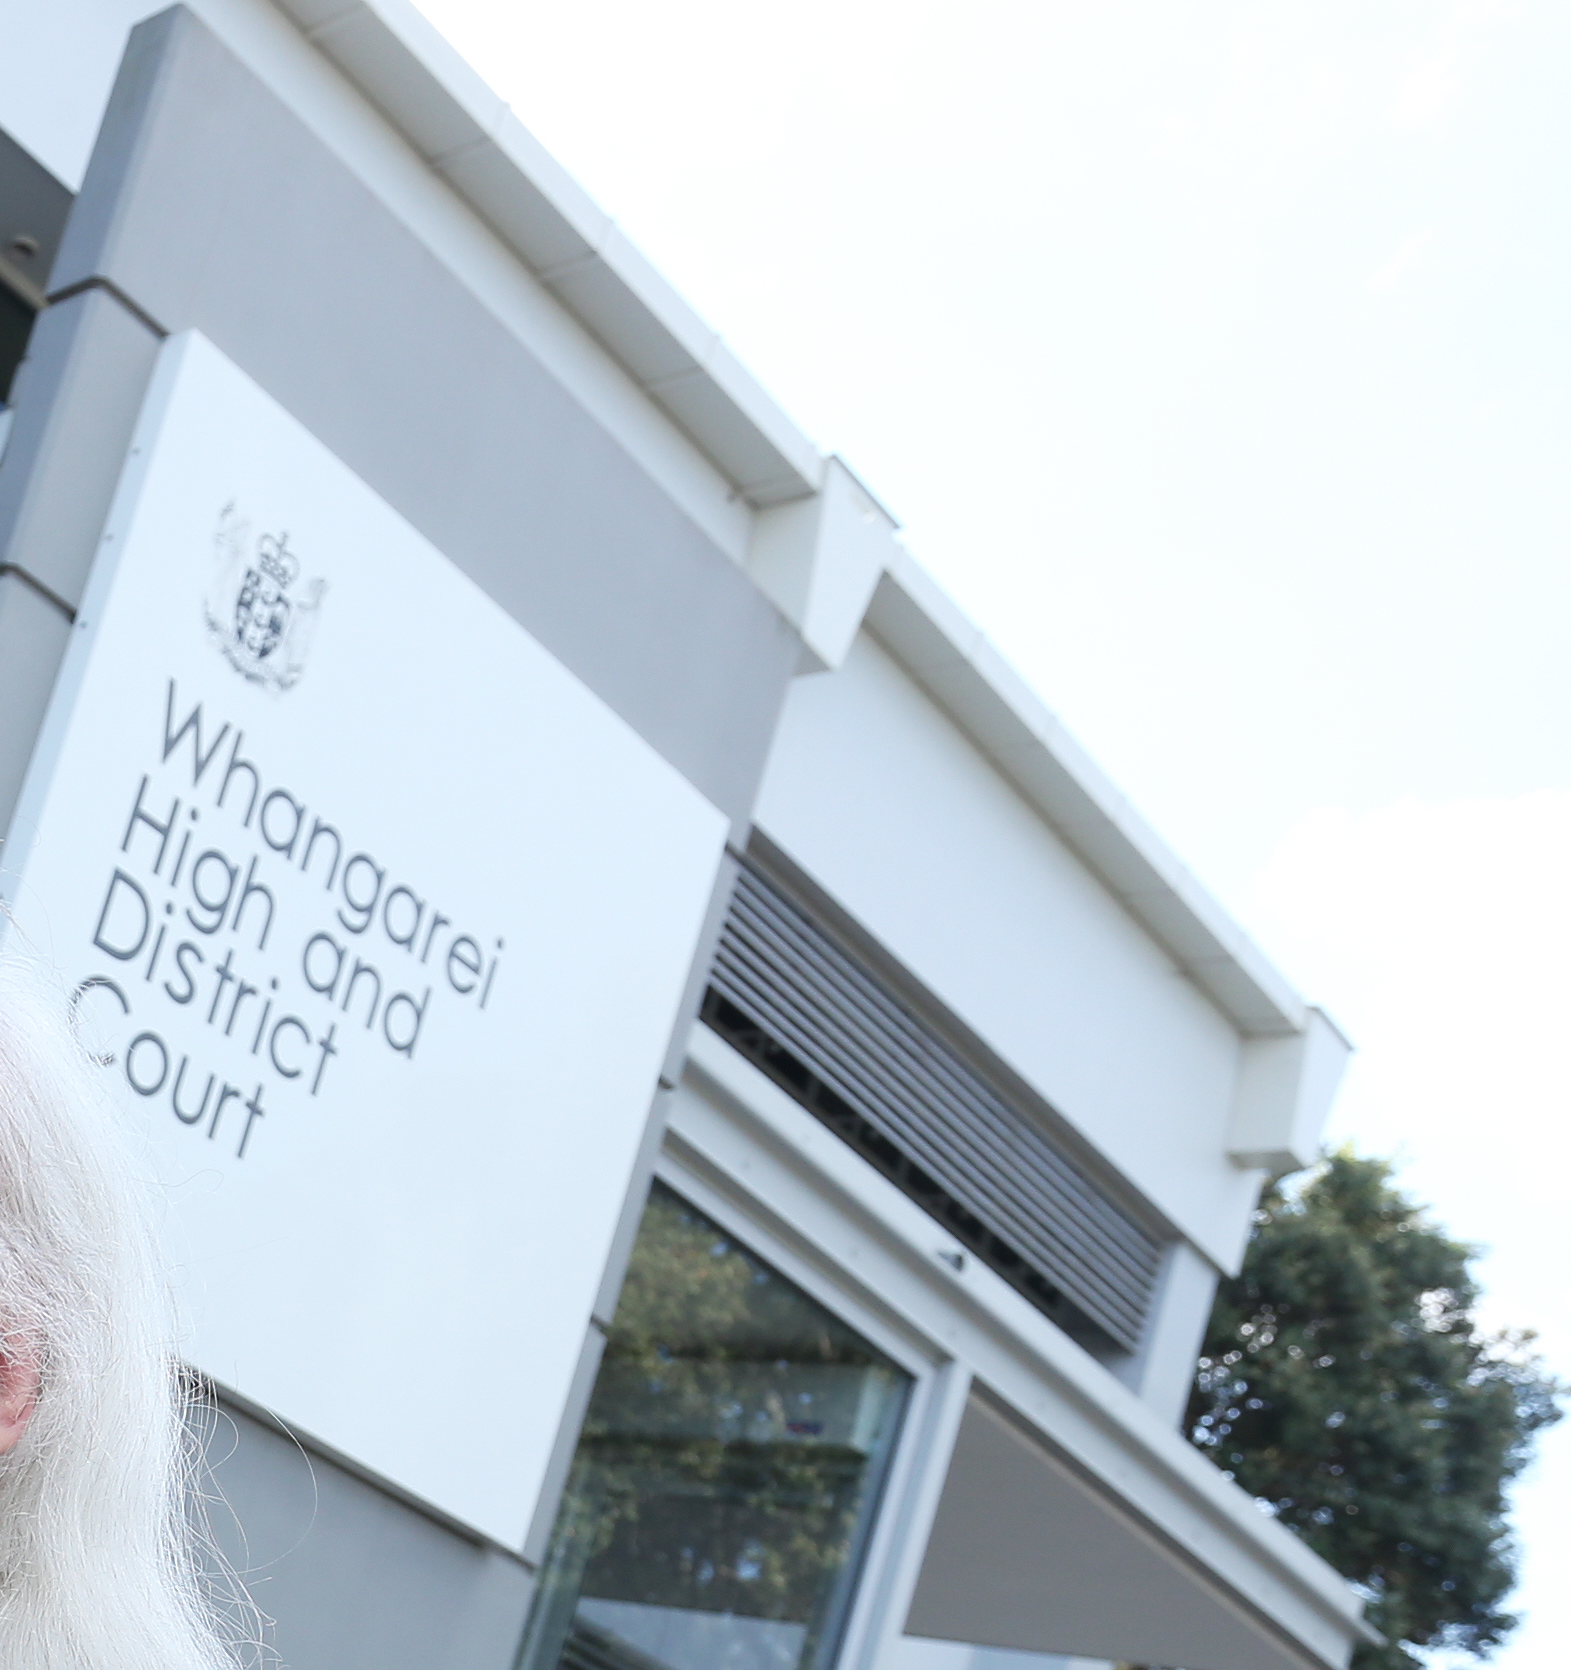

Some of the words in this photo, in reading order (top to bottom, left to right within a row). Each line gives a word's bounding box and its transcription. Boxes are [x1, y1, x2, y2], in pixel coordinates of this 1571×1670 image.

[120, 774, 278, 951] High
[301, 929, 432, 1060] and
[161, 677, 506, 1009] Whangarei
[66, 971, 266, 1160] Court
[92, 867, 339, 1097] District
